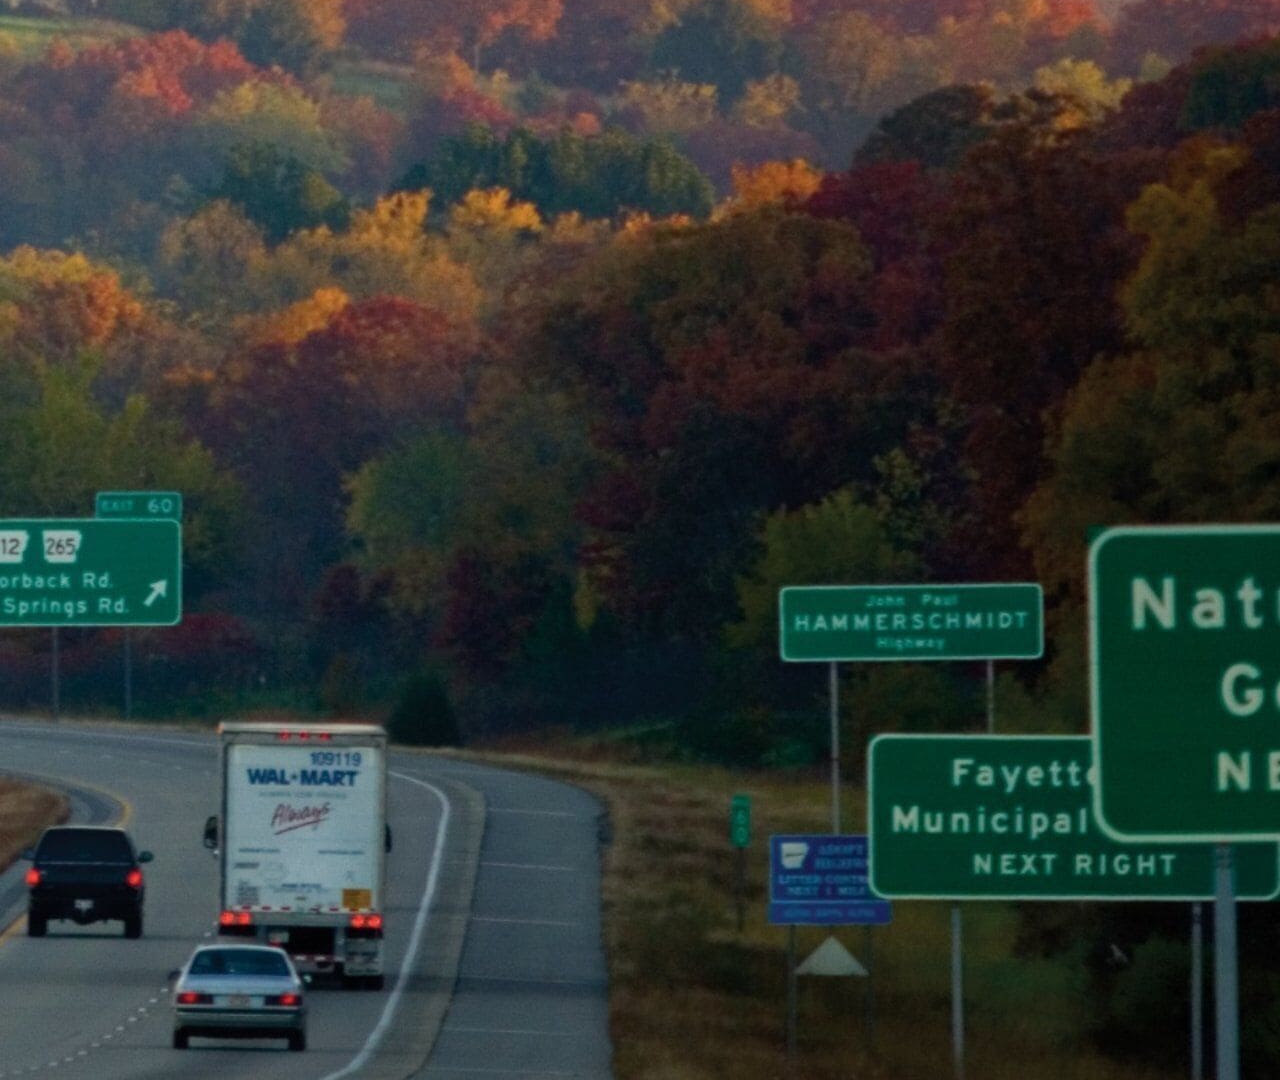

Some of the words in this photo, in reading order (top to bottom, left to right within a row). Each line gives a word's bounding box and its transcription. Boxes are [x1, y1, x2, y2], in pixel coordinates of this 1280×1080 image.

[147, 498, 173, 513] 60
[45, 538, 76, 556] 265
[82, 573, 114, 589] Rd.
[3, 598, 88, 618] Springs
[98, 597, 130, 613] Rd.
[866, 595, 905, 607] John
[921, 594, 959, 605] Paul
[1130, 577, 1280, 631] Nat
[794, 612, 1029, 632] HAMMERSCHMIDT
[876, 637, 946, 651] Highway
[1221, 663, 1280, 716] G
[310, 752, 361, 766] 109119
[271, 802, 332, 831] Always
[891, 806, 1088, 840] Municipal
[973, 854, 1058, 875] NEXT
[1075, 854, 1176, 875] RIGHT
